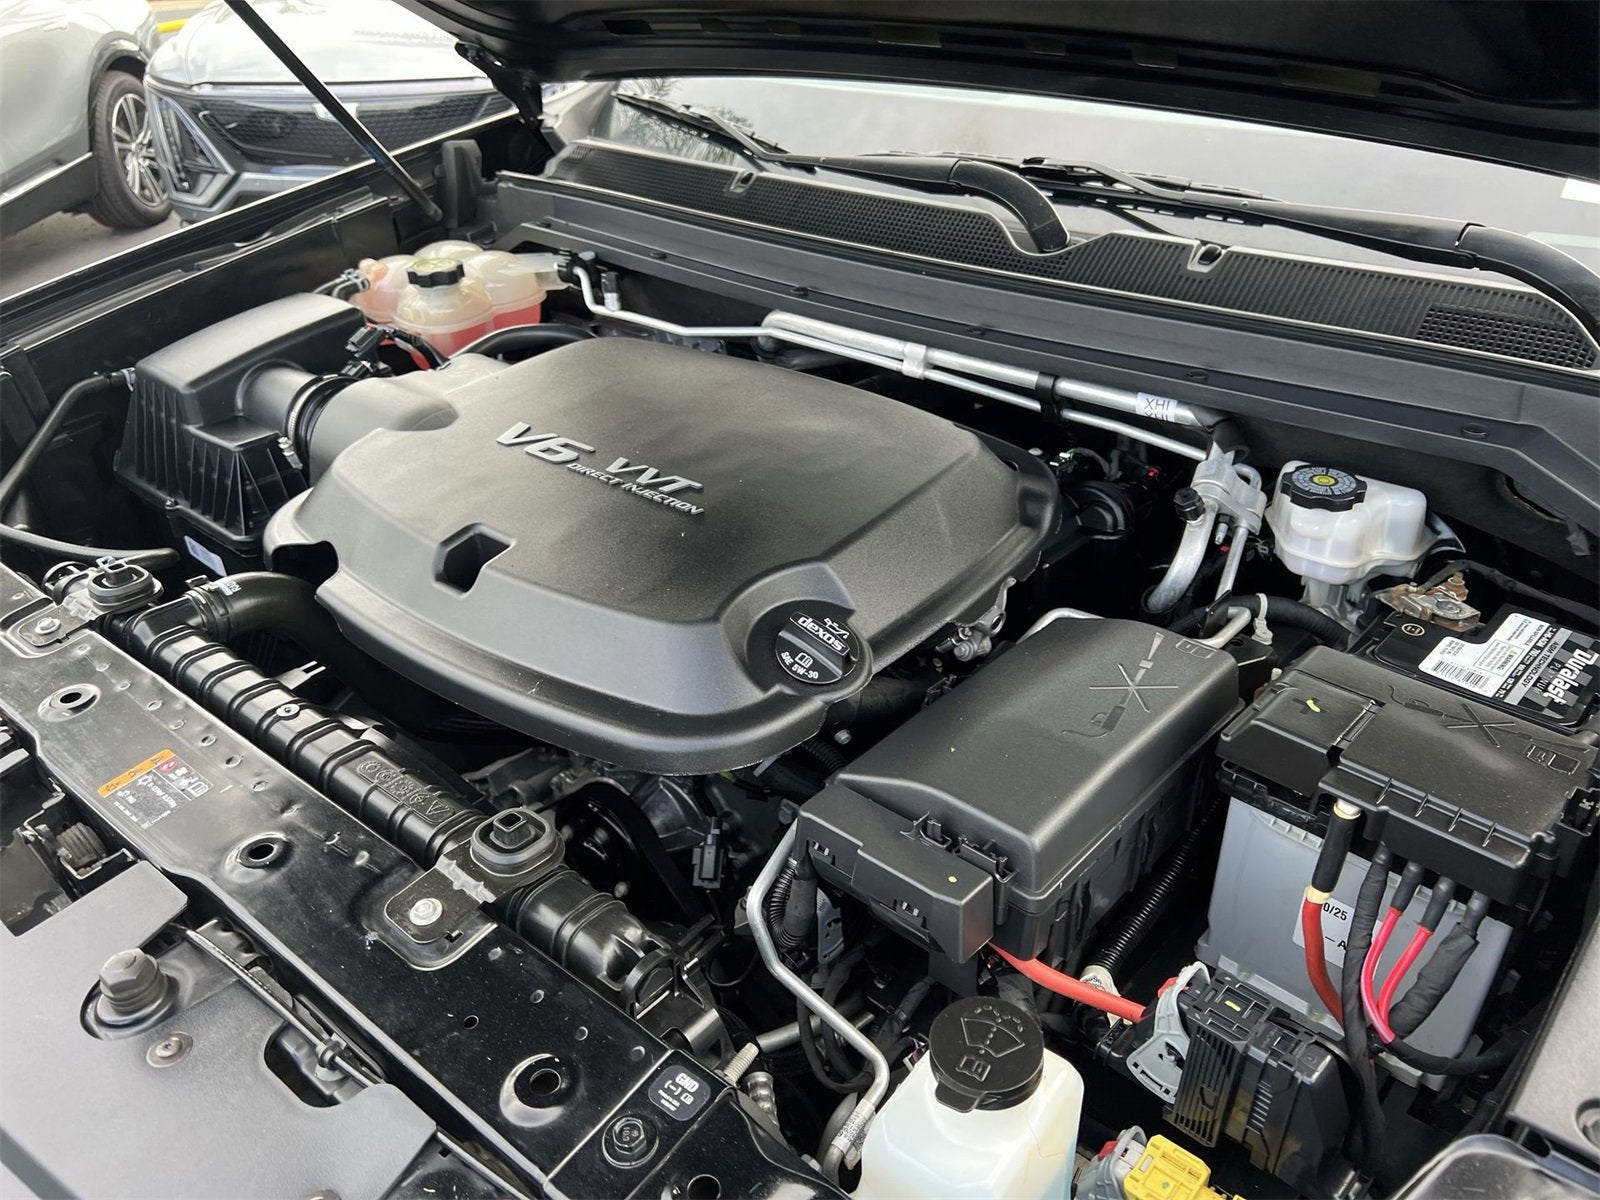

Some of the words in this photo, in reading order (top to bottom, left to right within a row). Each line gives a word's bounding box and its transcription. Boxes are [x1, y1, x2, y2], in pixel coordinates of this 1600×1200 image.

[496, 421, 595, 464] V6
[605, 456, 704, 494] VVT
[566, 462, 624, 486] DIRECT
[621, 482, 705, 515] INJECTION
[797, 616, 846, 651] dexos
[1546, 641, 1560, 654] AGM
[781, 651, 793, 666] SAE
[791, 663, 819, 679] 5W-30
[1521, 653, 1551, 688] TECHNOLOGY
[1542, 648, 1600, 704] Duralast
[675, 1072, 700, 1093] GND
